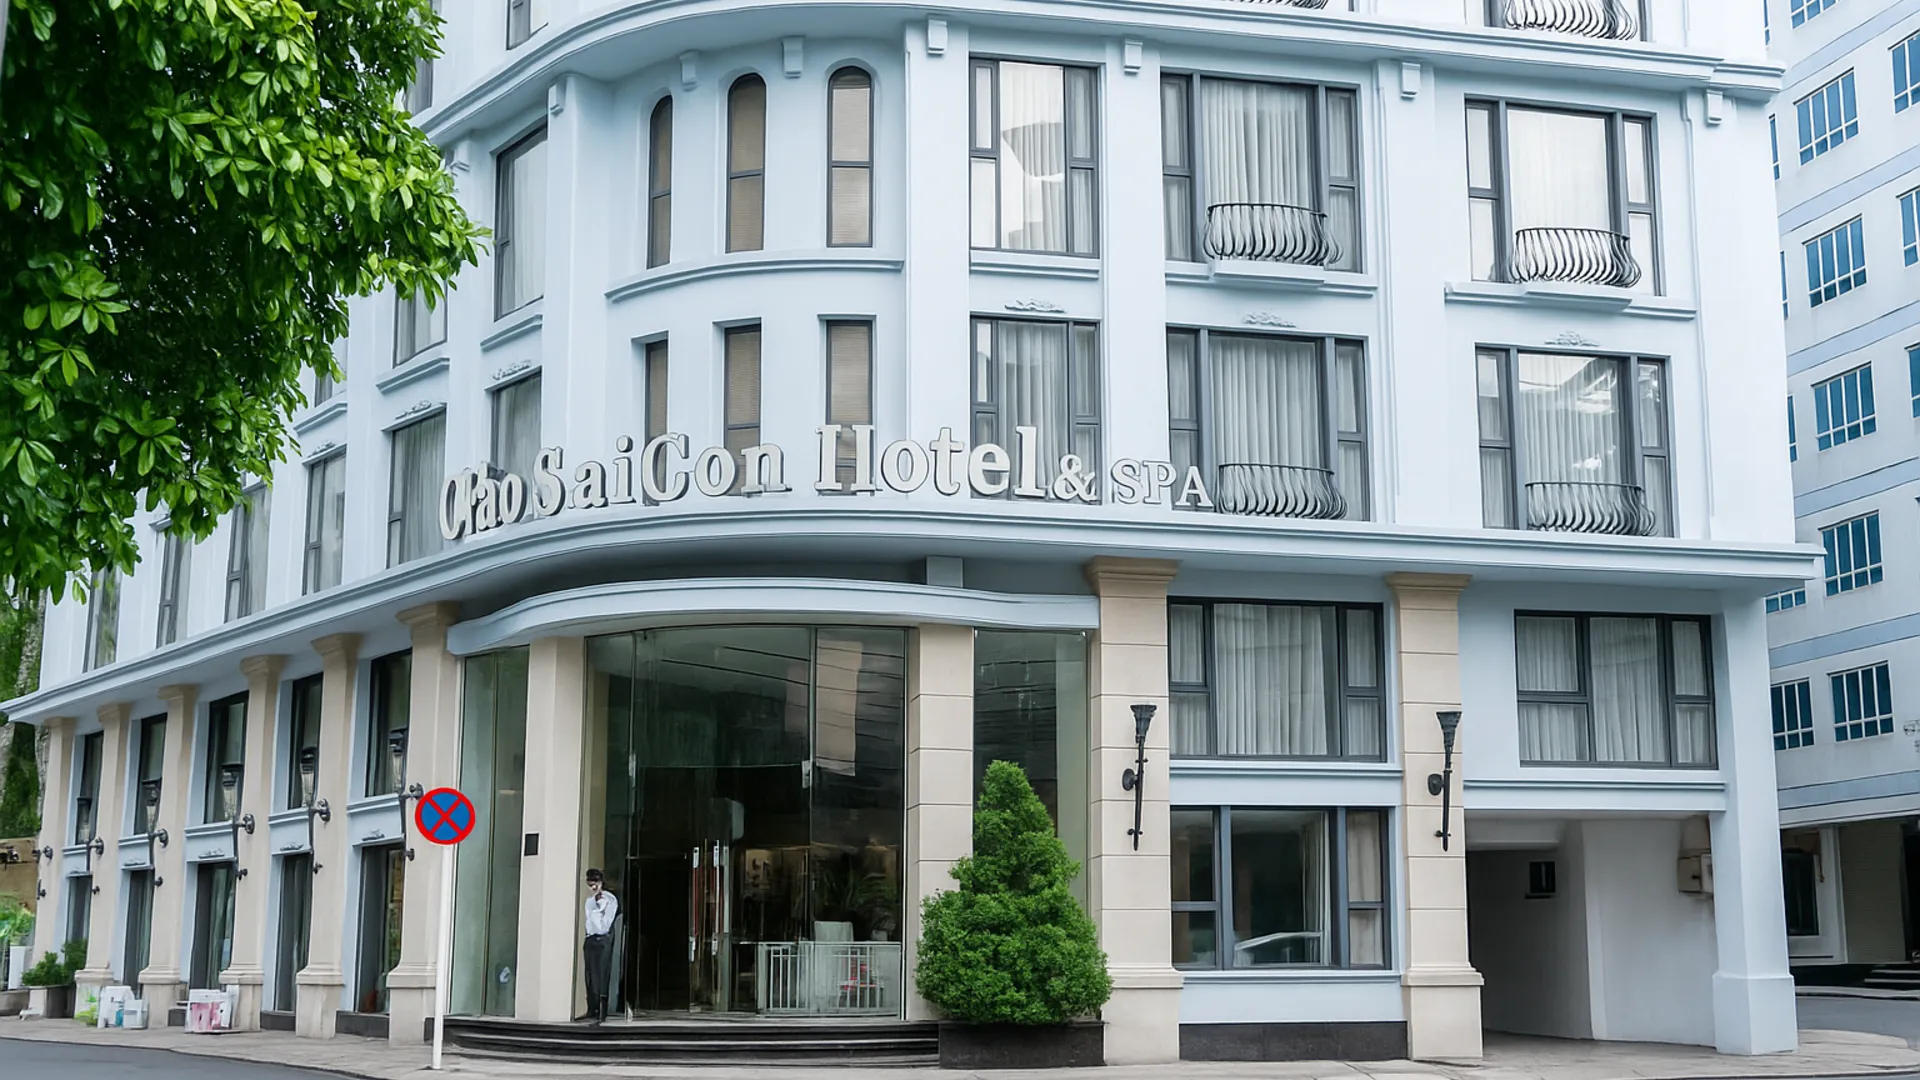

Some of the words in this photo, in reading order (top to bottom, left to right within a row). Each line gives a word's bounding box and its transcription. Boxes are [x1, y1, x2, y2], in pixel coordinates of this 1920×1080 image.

[815, 424, 1046, 496] Hotel
[1053, 454, 1097, 501] &
[1111, 458, 1215, 507] SPA
